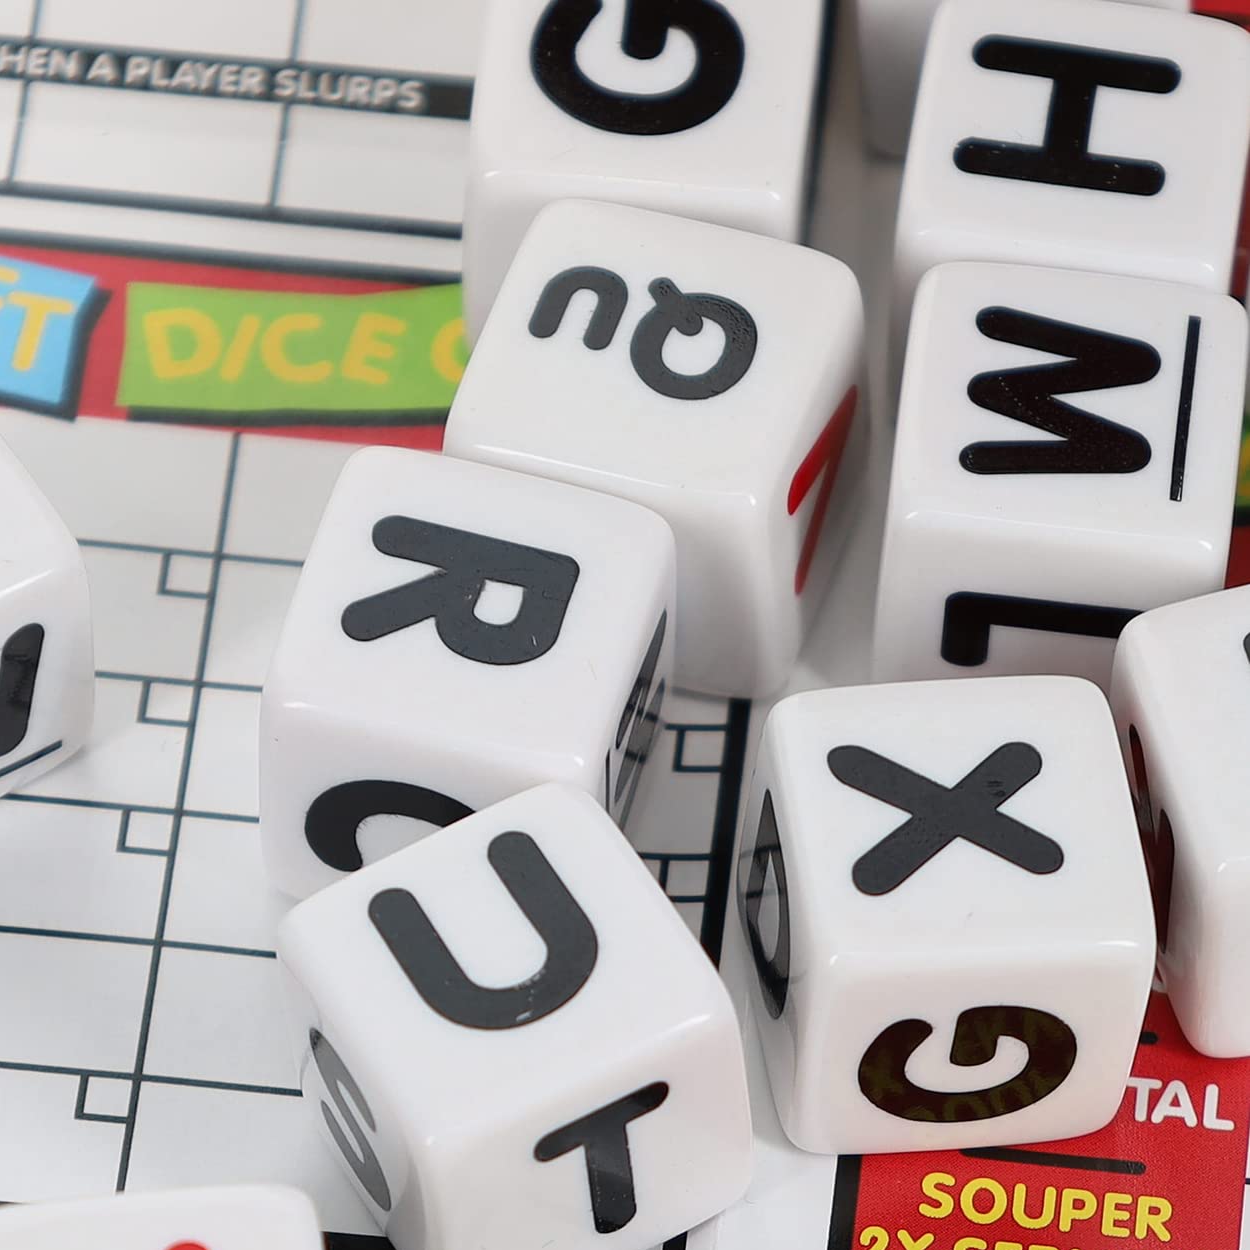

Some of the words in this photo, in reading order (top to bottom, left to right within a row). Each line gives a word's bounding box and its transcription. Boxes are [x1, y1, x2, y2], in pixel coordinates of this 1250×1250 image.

[85, 51, 117, 84] A
[123, 54, 266, 97] PLAYER
[273, 67, 427, 109] SLURPS
[952, 33, 1182, 197] H
[142, 306, 409, 387] DICE
[341, 515, 580, 665] R
[827, 742, 1064, 895] X
[368, 831, 599, 1030] U
[858, 1005, 1077, 1122] G
[1126, 1076, 1236, 1131] TAL
[533, 1081, 669, 1234] T
[919, 1172, 1173, 1243] SOUPER
